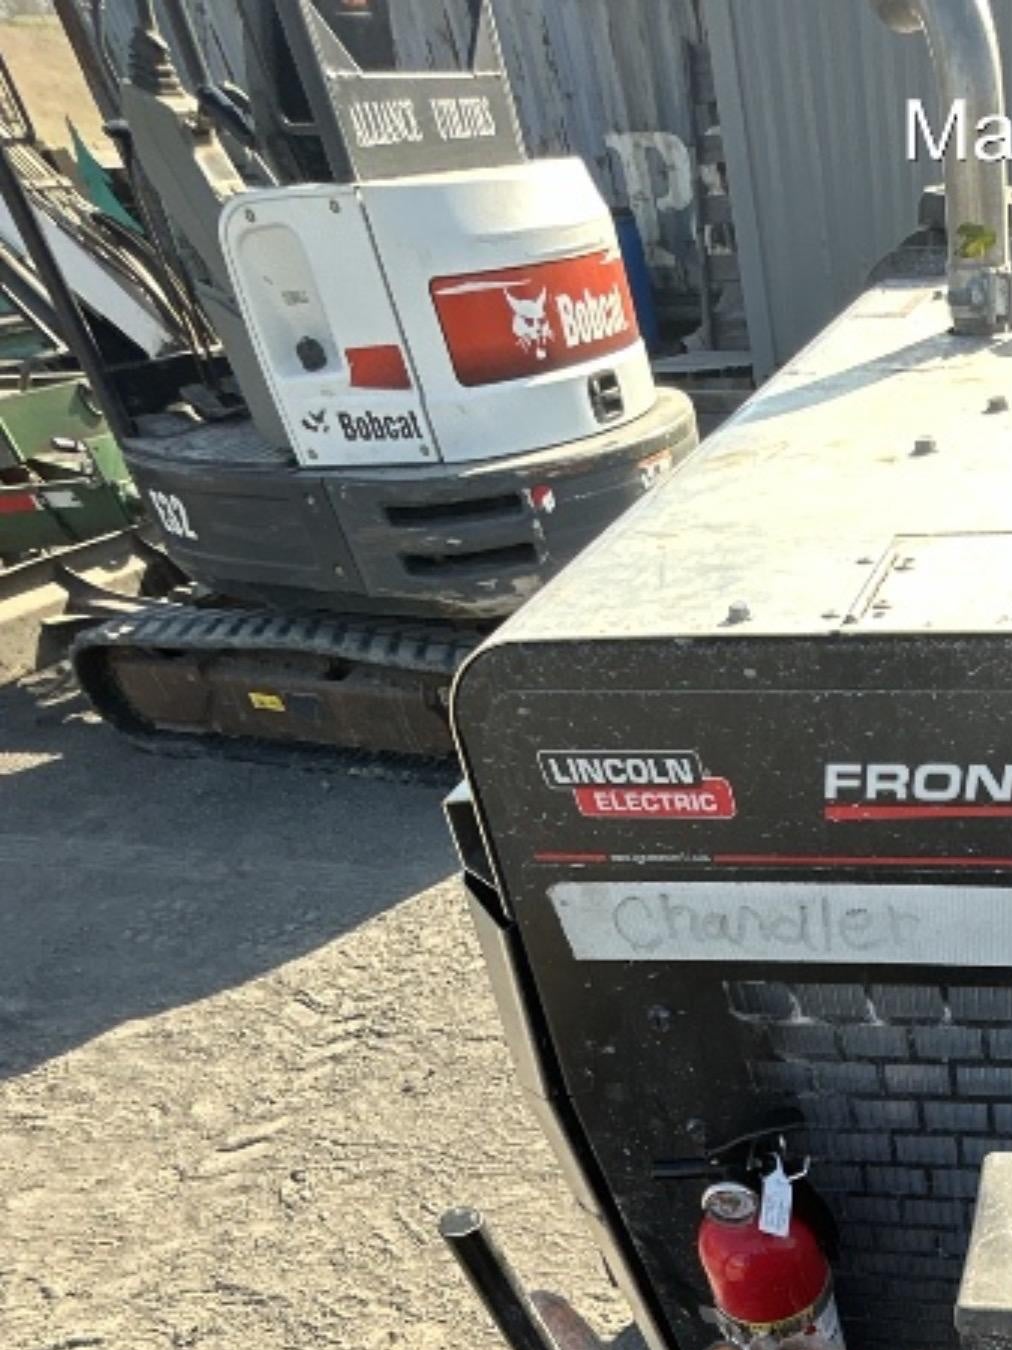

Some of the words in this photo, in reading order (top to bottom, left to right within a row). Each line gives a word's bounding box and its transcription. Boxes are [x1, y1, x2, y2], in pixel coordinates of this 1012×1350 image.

[555, 284, 629, 348] Bobcat
[337, 410, 423, 441] Bobcat
[548, 758, 694, 784] LINCOLN
[593, 791, 718, 812] ELECTRIC
[611, 893, 922, 953] Chandler
